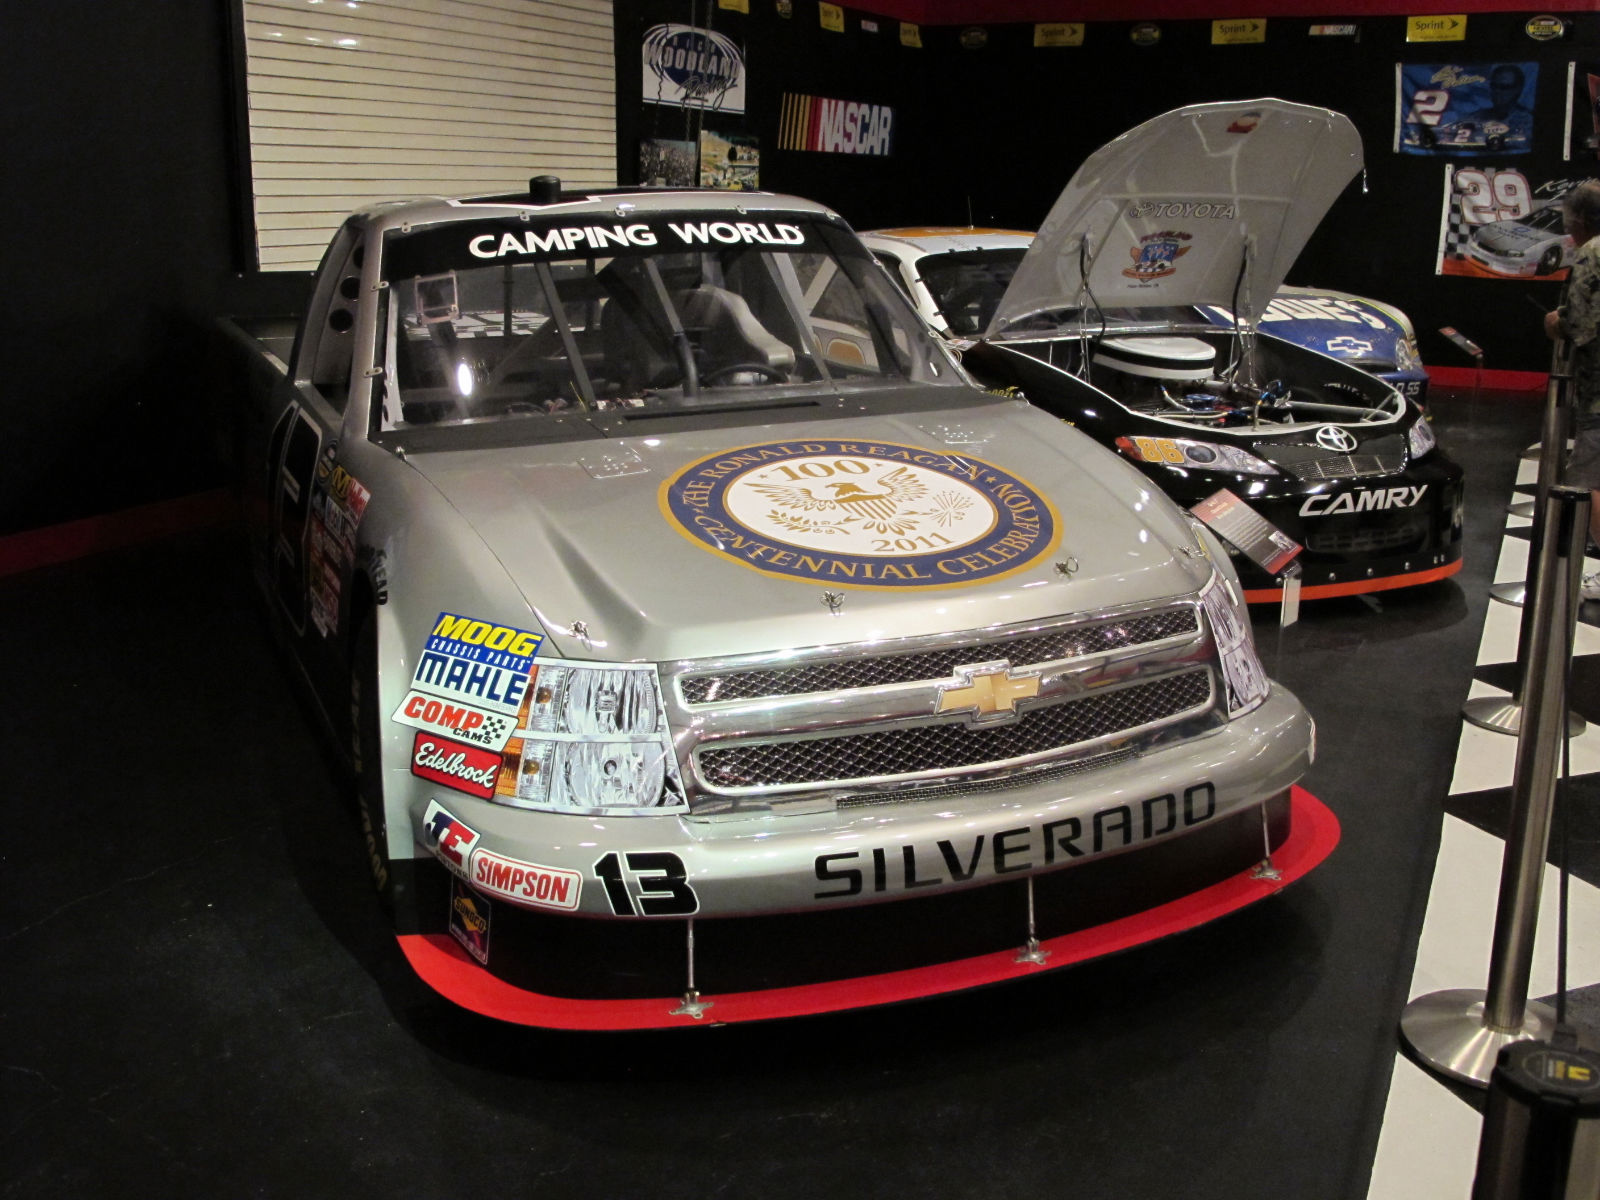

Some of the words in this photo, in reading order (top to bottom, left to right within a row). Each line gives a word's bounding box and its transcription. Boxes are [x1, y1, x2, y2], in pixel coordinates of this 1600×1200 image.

[1219, 24, 1246, 35] Sprint
[1415, 20, 1444, 31] Sprint
[1406, 90, 1449, 126] 2
[818, 98, 893, 155] NASCAR
[1156, 203, 1236, 218] TOYOTA
[1456, 169, 1532, 224] 29
[469, 225, 657, 259] CAMPING
[668, 223, 806, 246] WORLD
[1135, 438, 1185, 463] 86
[683, 480, 715, 507] THE
[705, 443, 827, 480] RONALD
[836, 443, 988, 480] REAGAN
[772, 459, 871, 482] 100
[1299, 484, 1428, 517] CAMRY
[692, 516, 933, 580] CENTENNIAL
[936, 482, 1042, 576] CELEBRATION
[871, 531, 955, 553] 2011
[432, 615, 542, 657] MOOG
[431, 639, 481, 659] CHASSIS
[486, 652, 526, 670] PARTS
[415, 651, 529, 707] MAHLE
[404, 696, 484, 731] COMP
[453, 728, 493, 745] CAMS
[415, 743, 498, 788] Edelbrock
[425, 811, 474, 867] JE
[814, 781, 1215, 899] SILVERADO
[476, 858, 571, 903] SIMPSON
[593, 851, 700, 917] 13
[453, 897, 487, 933] SUNOCO
